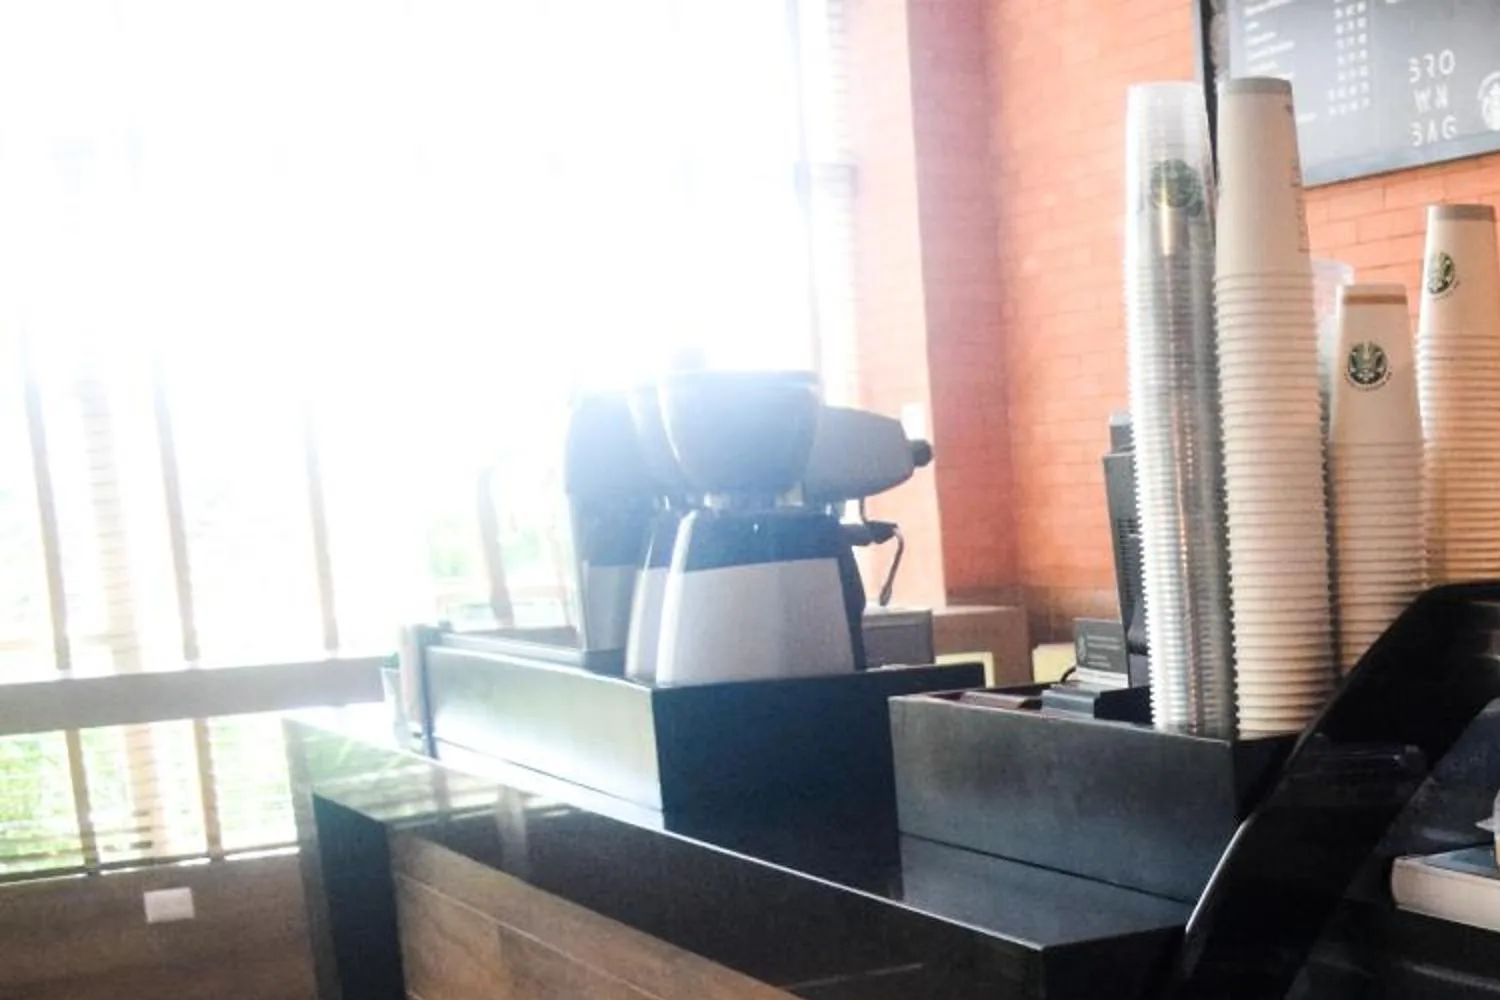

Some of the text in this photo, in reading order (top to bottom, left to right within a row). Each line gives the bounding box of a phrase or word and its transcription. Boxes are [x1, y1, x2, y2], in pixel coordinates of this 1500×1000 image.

[1407, 48, 1456, 84] BRO
[1413, 83, 1448, 113] WN
[1408, 114, 1457, 147] BAG
